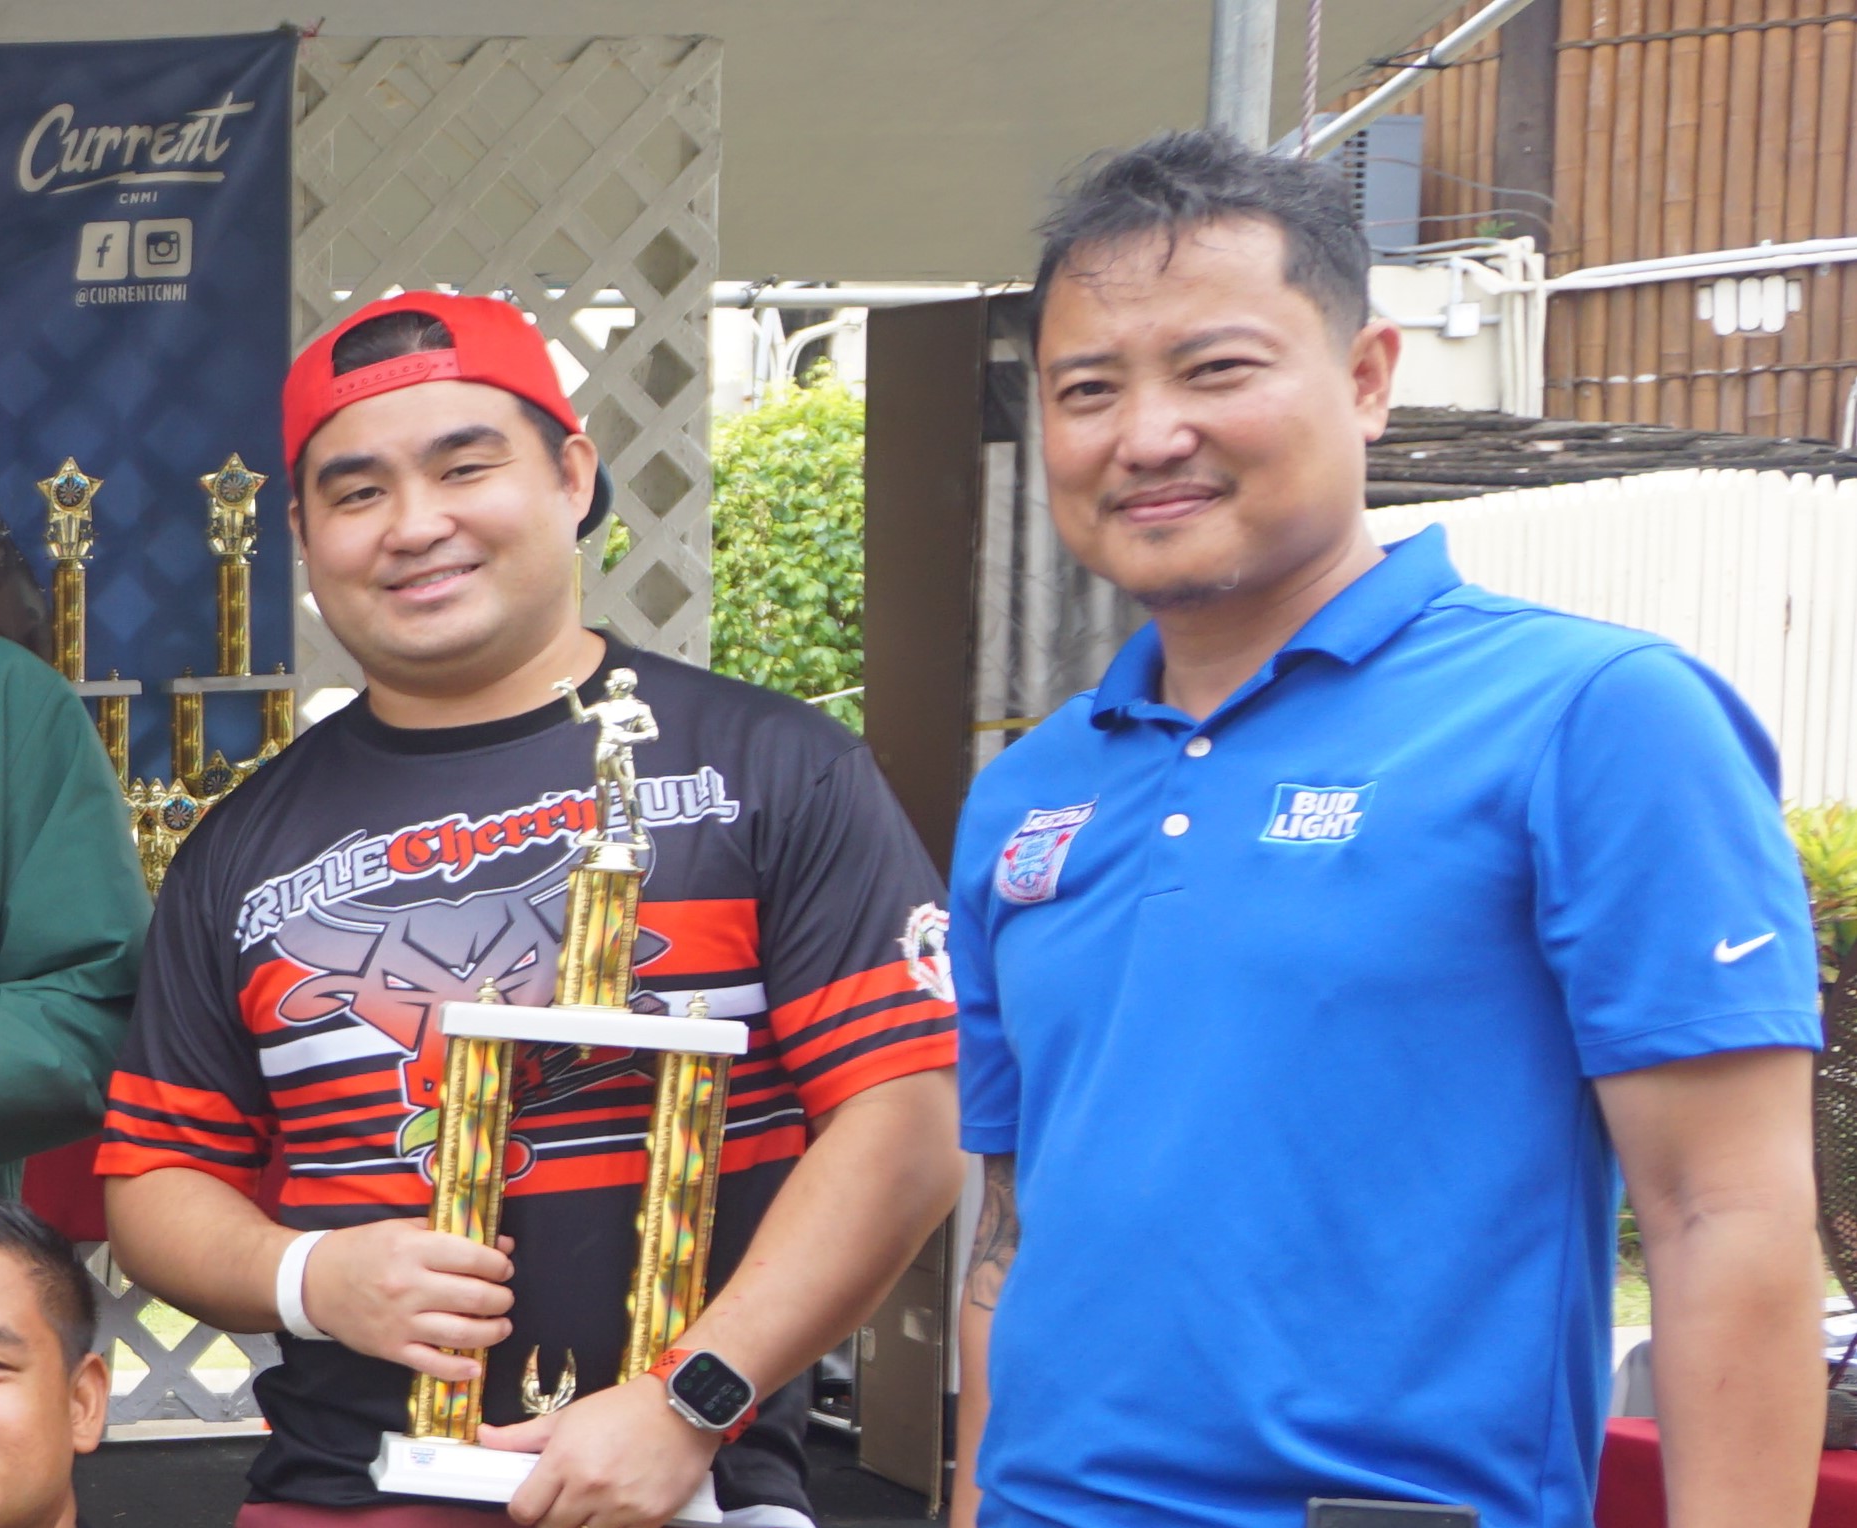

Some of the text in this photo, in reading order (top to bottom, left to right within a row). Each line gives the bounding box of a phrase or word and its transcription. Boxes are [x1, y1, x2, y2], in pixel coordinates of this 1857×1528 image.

[19, 91, 255, 192] Current
[118, 191, 158, 205] CNMI
[75, 283, 188, 308] @CURRENTCNMI
[1291, 791, 1360, 816] BUD
[1269, 811, 1363, 840] LIGHT
